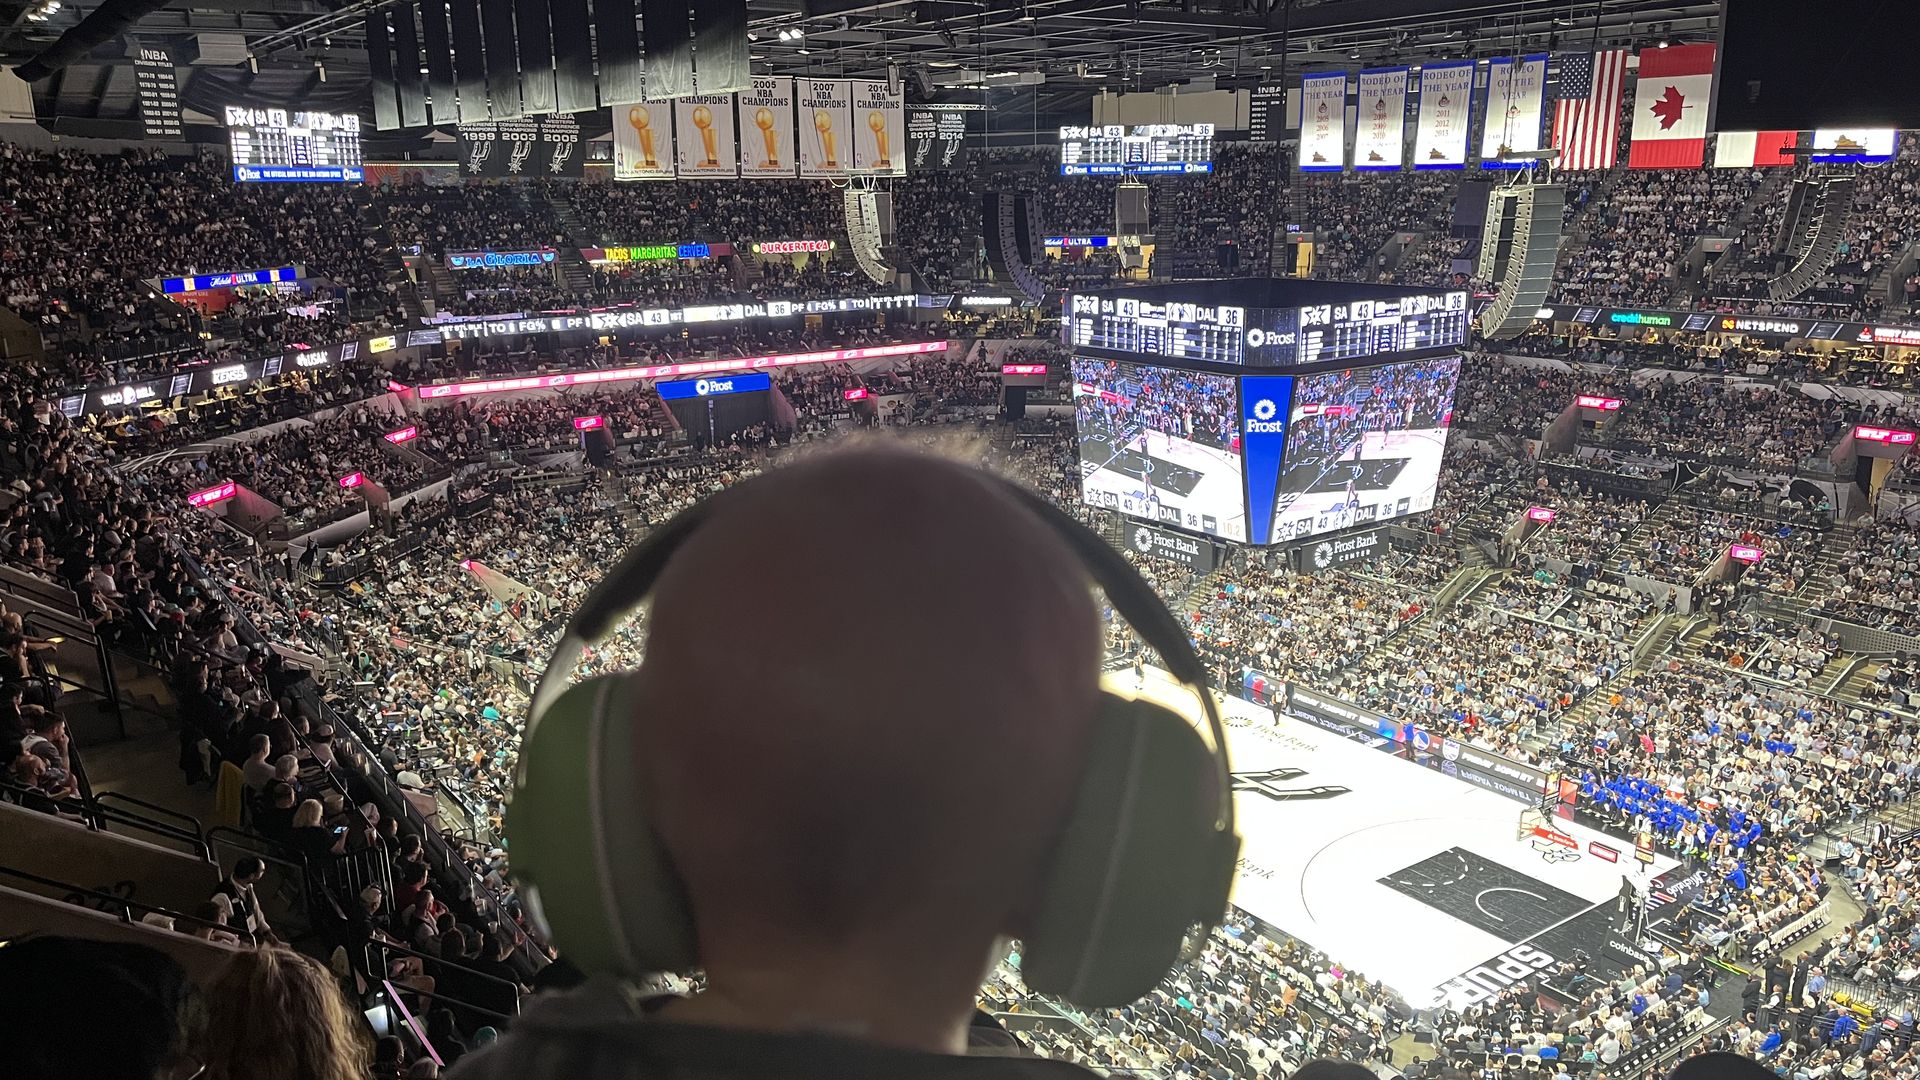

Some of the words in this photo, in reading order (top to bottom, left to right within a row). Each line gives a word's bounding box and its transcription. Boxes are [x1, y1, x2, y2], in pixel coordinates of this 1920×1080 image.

[144, 49, 168, 61] NBA
[1424, 70, 1456, 80] RODEO
[1458, 69, 1472, 77] OF
[1500, 65, 1534, 75] RODEO
[1306, 80, 1331, 88] RODEO
[1361, 76, 1390, 86] RODEO
[1394, 75, 1406, 83] OF
[1515, 77, 1534, 86] THE
[757, 89, 773, 97] NBA
[1381, 88, 1404, 96] YEAR
[1424, 84, 1441, 92] THE
[1446, 82, 1469, 92] YEAR
[680, 96, 728, 104] CHAMPIONS
[742, 97, 788, 106] CHAMPIONS
[816, 92, 832, 100] NBA
[802, 99, 846, 108] CHAMPIONS
[857, 100, 900, 109] CHAMPIONS
[255, 110, 268, 124] SA
[1090, 128, 1102, 136] SA
[1109, 127, 1119, 136] 43
[1177, 126, 1194, 134] DAL
[1199, 125, 1209, 134] 36
[544, 134, 578, 142] 2005
[604, 248, 628, 260] TACOS
[630, 246, 677, 260] MARGARITAS
[678, 244, 709, 258] CERVEZA
[760, 241, 828, 253] BURGERTECA
[466, 257, 484, 267] LA
[485, 252, 541, 266] GLORIA
[236, 273, 257, 282] ULTRA
[1102, 300, 1114, 313] SA
[1123, 302, 1134, 315] 43
[1428, 296, 1445, 310] DAL
[1452, 295, 1461, 309] 36
[489, 323, 506, 333] TO
[519, 319, 546, 332] FG%
[567, 318, 583, 328] PF
[626, 314, 643, 325] SA
[651, 311, 662, 322] 43
[745, 304, 767, 317] DAL
[774, 303, 785, 315] 36
[792, 303, 803, 313] PF
[816, 301, 836, 311] FG%
[851, 299, 864, 308] TO
[1197, 308, 1217, 322] DAL
[1226, 310, 1238, 324] 36
[1335, 306, 1348, 320] SA
[1358, 304, 1368, 318] 43
[1612, 314, 1671, 326] credithuman
[1735, 320, 1799, 334] NETSPEND
[1265, 332, 1295, 345] Frost
[710, 380, 733, 392] Frost
[101, 392, 122, 406] TACO
[1246, 419, 1282, 432] Frost
[1104, 494, 1118, 507] SA
[1124, 500, 1132, 510] 43
[1160, 508, 1180, 522] DAL
[1188, 513, 1198, 526] 36
[1296, 521, 1312, 534] SA
[1318, 517, 1327, 529] 43
[1356, 508, 1376, 522] DAL
[1382, 503, 1392, 515] 36
[1154, 533, 1176, 549] Frost
[1176, 538, 1199, 555] Bank
[1335, 540, 1356, 553] Frost
[1356, 533, 1378, 547] Bank
[1159, 549, 1192, 562] CENTER
[1340, 549, 1371, 562] CENTER
